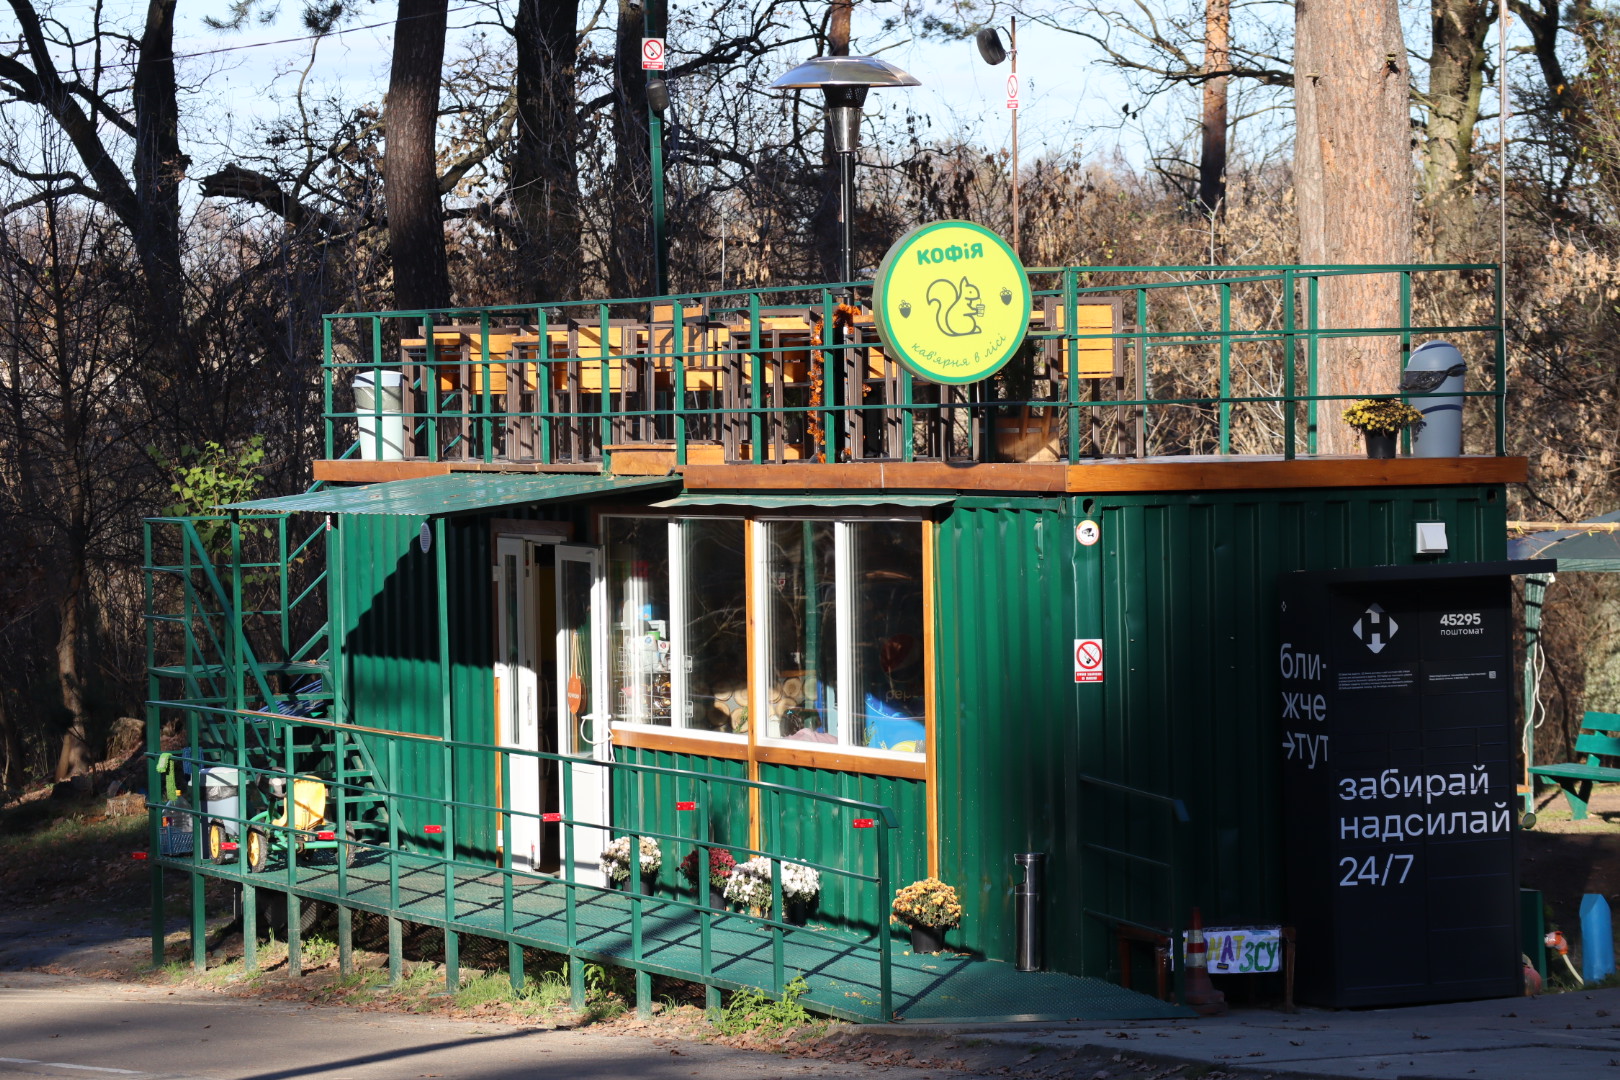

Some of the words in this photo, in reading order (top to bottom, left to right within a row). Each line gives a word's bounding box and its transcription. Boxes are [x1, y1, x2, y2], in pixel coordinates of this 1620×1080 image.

[911, 342, 971, 368] кав'ярня
[974, 351, 980, 363] в
[984, 332, 1007, 358] лісі
[1440, 613, 1482, 627] 45295
[1440, 626, 1484, 636] поштомат
[1281, 691, 1327, 721] жче
[1294, 731, 1329, 769] тут
[1339, 765, 1489, 804] забирай
[1340, 802, 1511, 842] надсилай
[1339, 853, 1415, 886] 24/7
